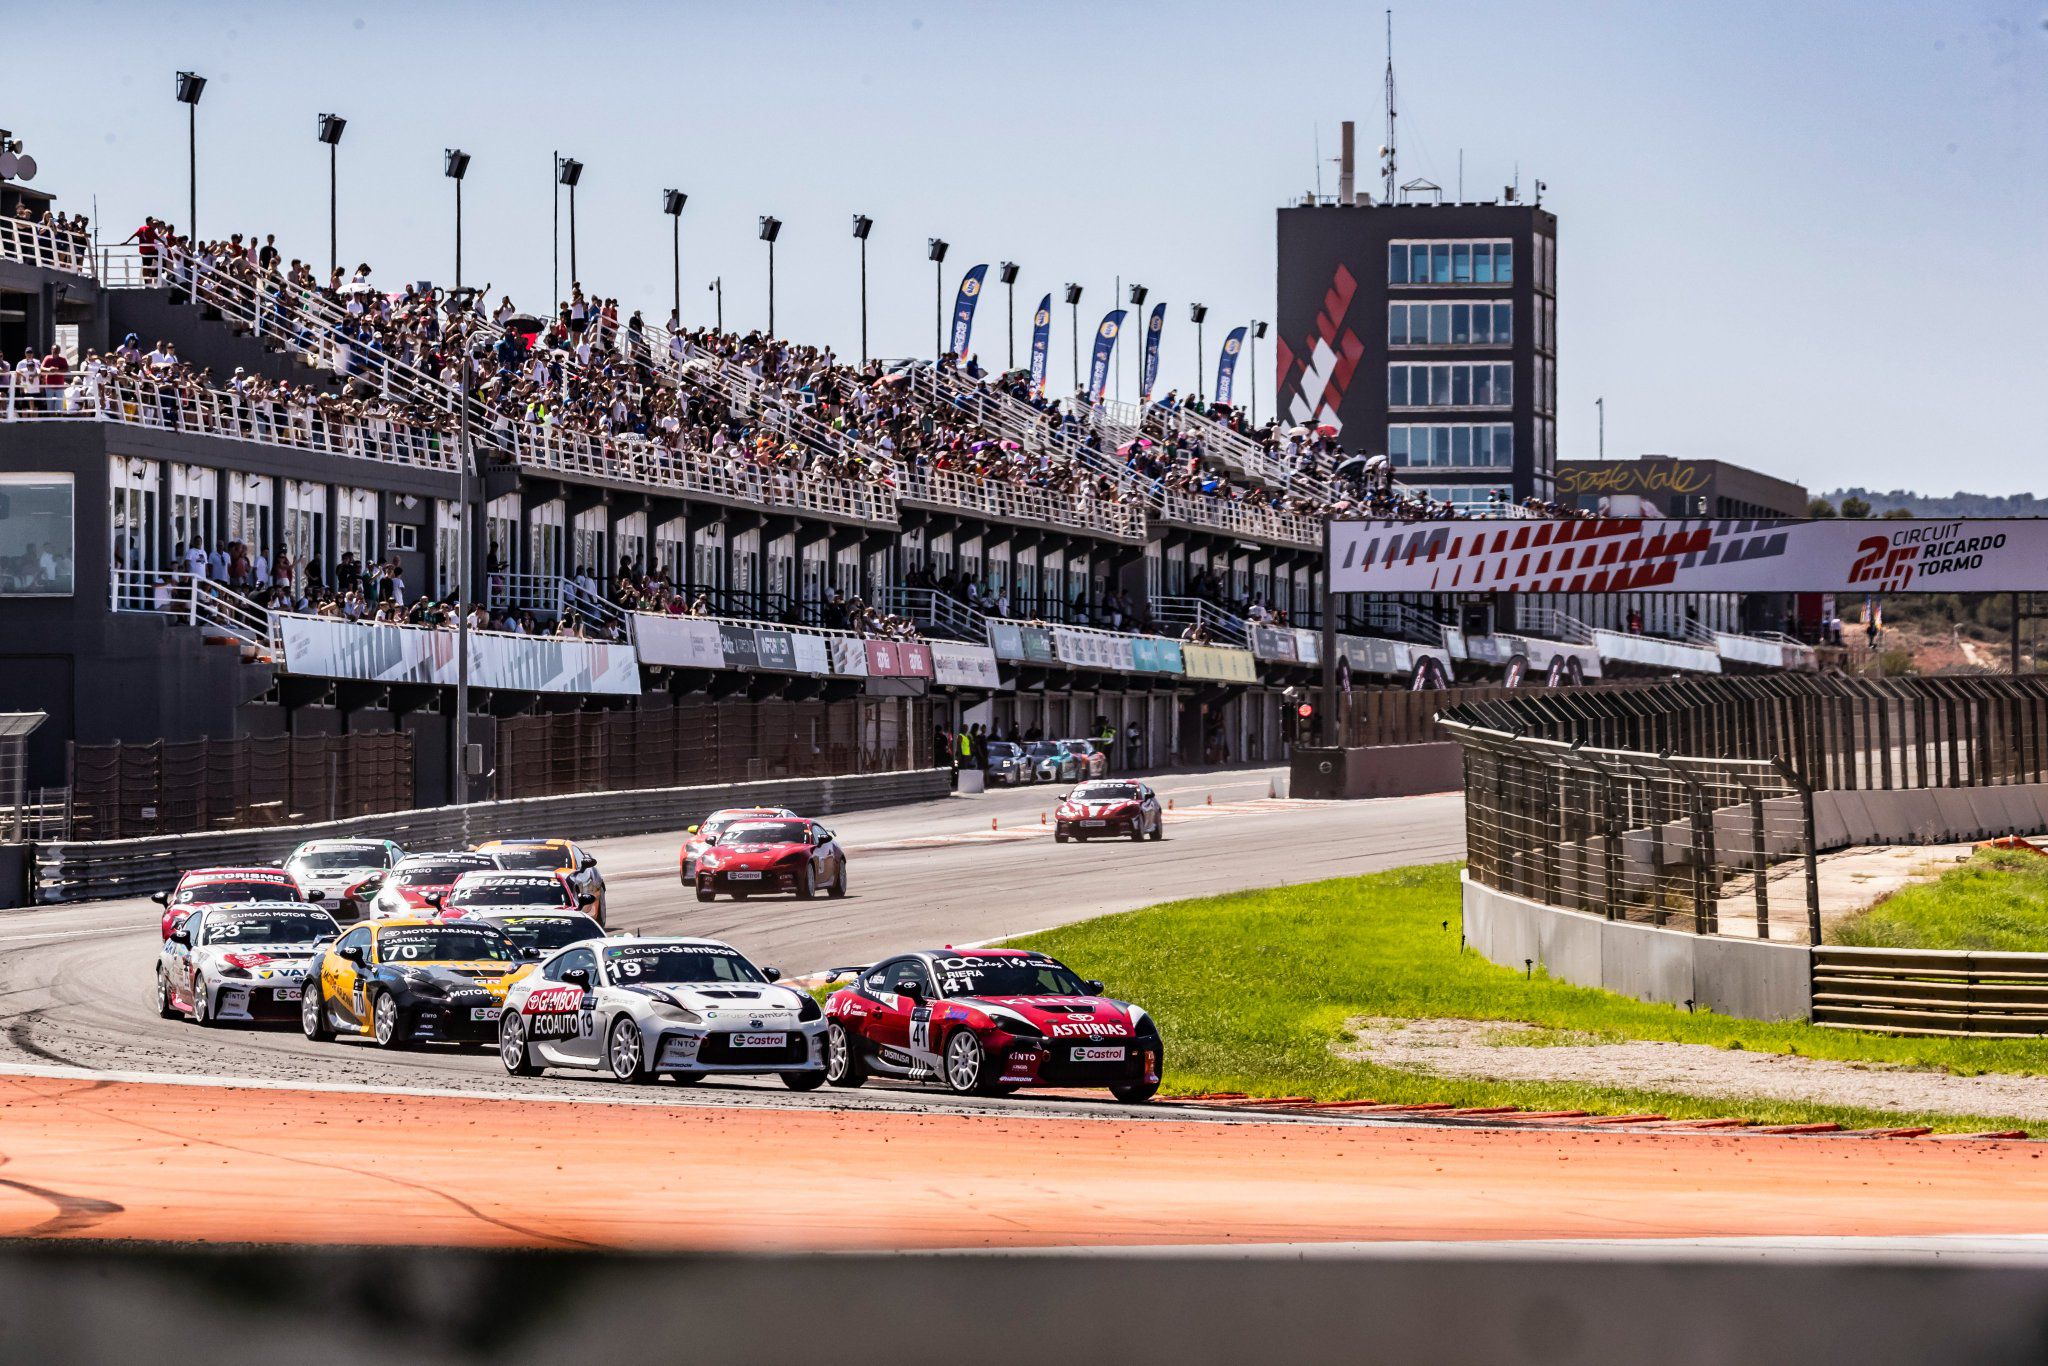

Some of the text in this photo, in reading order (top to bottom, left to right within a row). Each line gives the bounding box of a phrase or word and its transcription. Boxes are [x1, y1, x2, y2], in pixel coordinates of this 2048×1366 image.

[1893, 522, 1963, 546] CIRCUIT
[1923, 533, 2007, 559] RICARDO
[1918, 554, 1983, 577] TORMO
[181, 891, 194, 903] 9
[231, 911, 271, 919] CUMACA
[210, 925, 241, 940] 23
[402, 928, 483, 936] MOTOR ARJONA
[384, 936, 427, 945] CASTILLA
[383, 945, 418, 961] 70
[606, 962, 642, 979] 19
[946, 969, 985, 979] RIERA
[943, 977, 975, 993] 41
[450, 988, 491, 998] MOTOR
[535, 1013, 578, 1034] ECOAUTO
[581, 1013, 594, 1037] 19
[1051, 1023, 1128, 1037] ASTURIAS
[746, 1036, 784, 1046] Castrol
[912, 1025, 927, 1048] 41
[1087, 1049, 1122, 1059] Castrol
